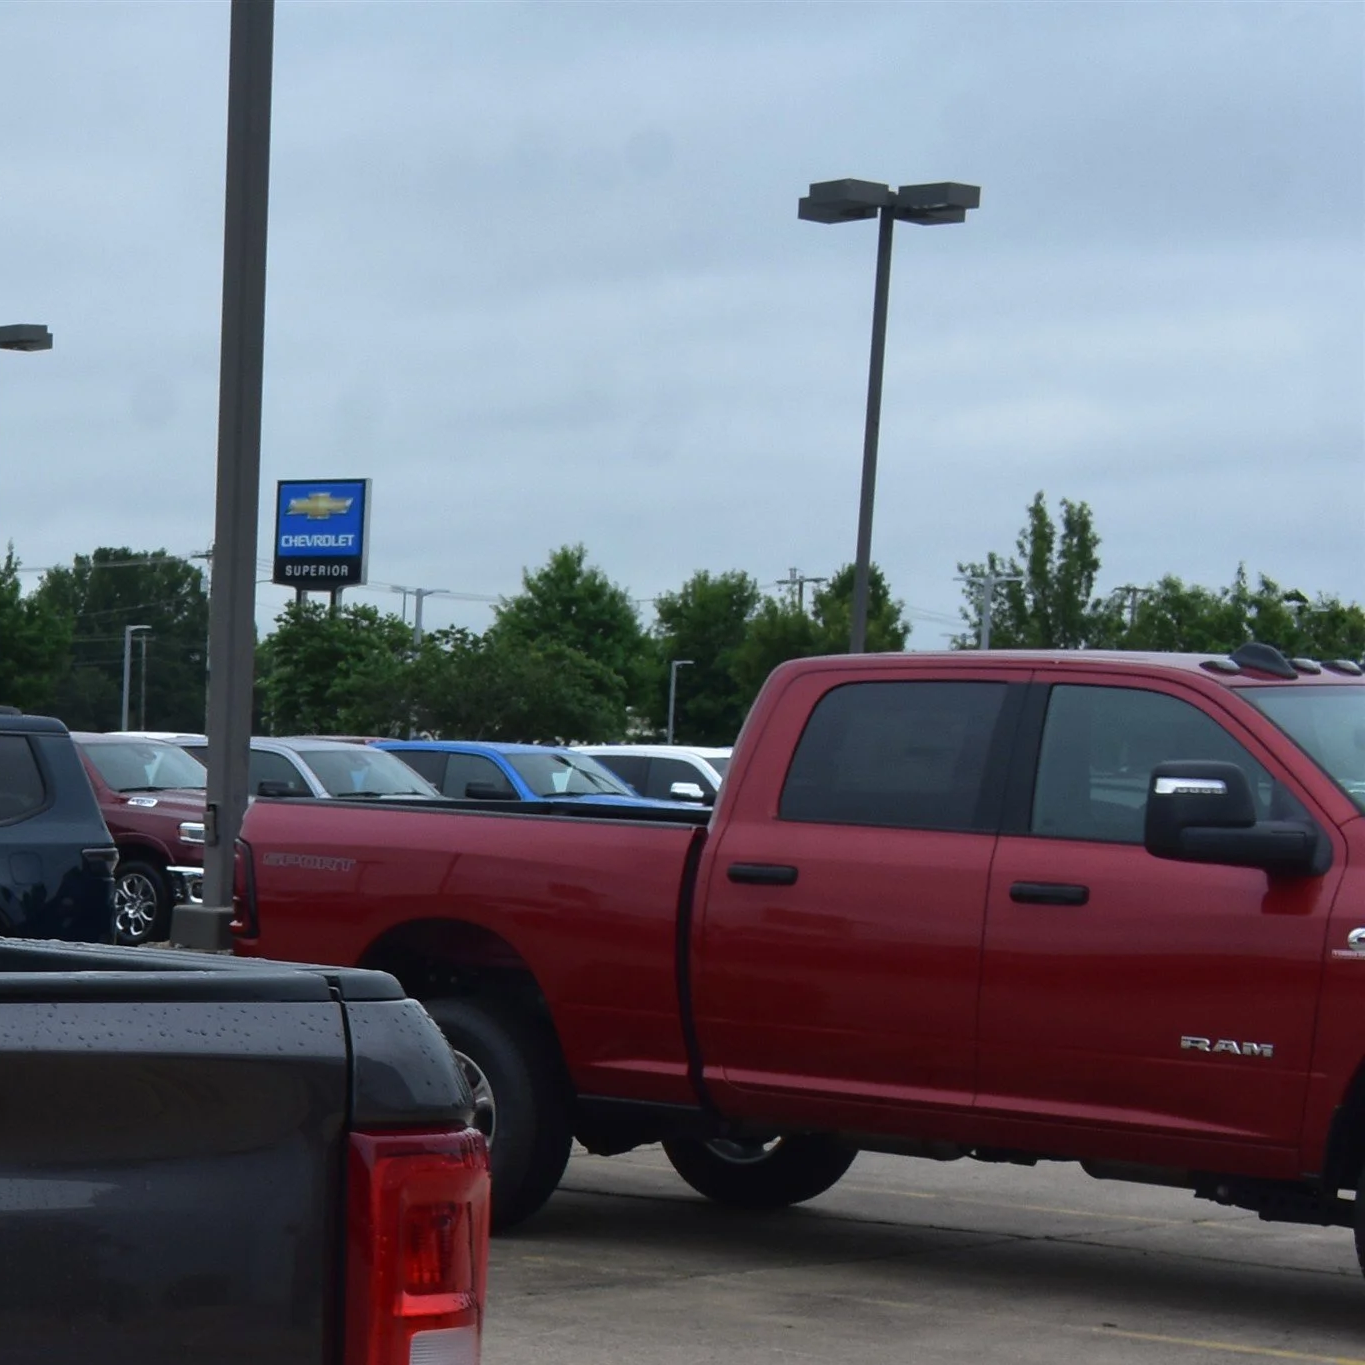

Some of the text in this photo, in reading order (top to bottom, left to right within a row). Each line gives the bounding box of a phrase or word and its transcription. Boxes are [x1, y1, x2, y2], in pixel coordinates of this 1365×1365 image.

[281, 534, 355, 548] CHEVROLET
[285, 564, 349, 577] SUPERIOR
[1180, 1035, 1274, 1058] RAM
